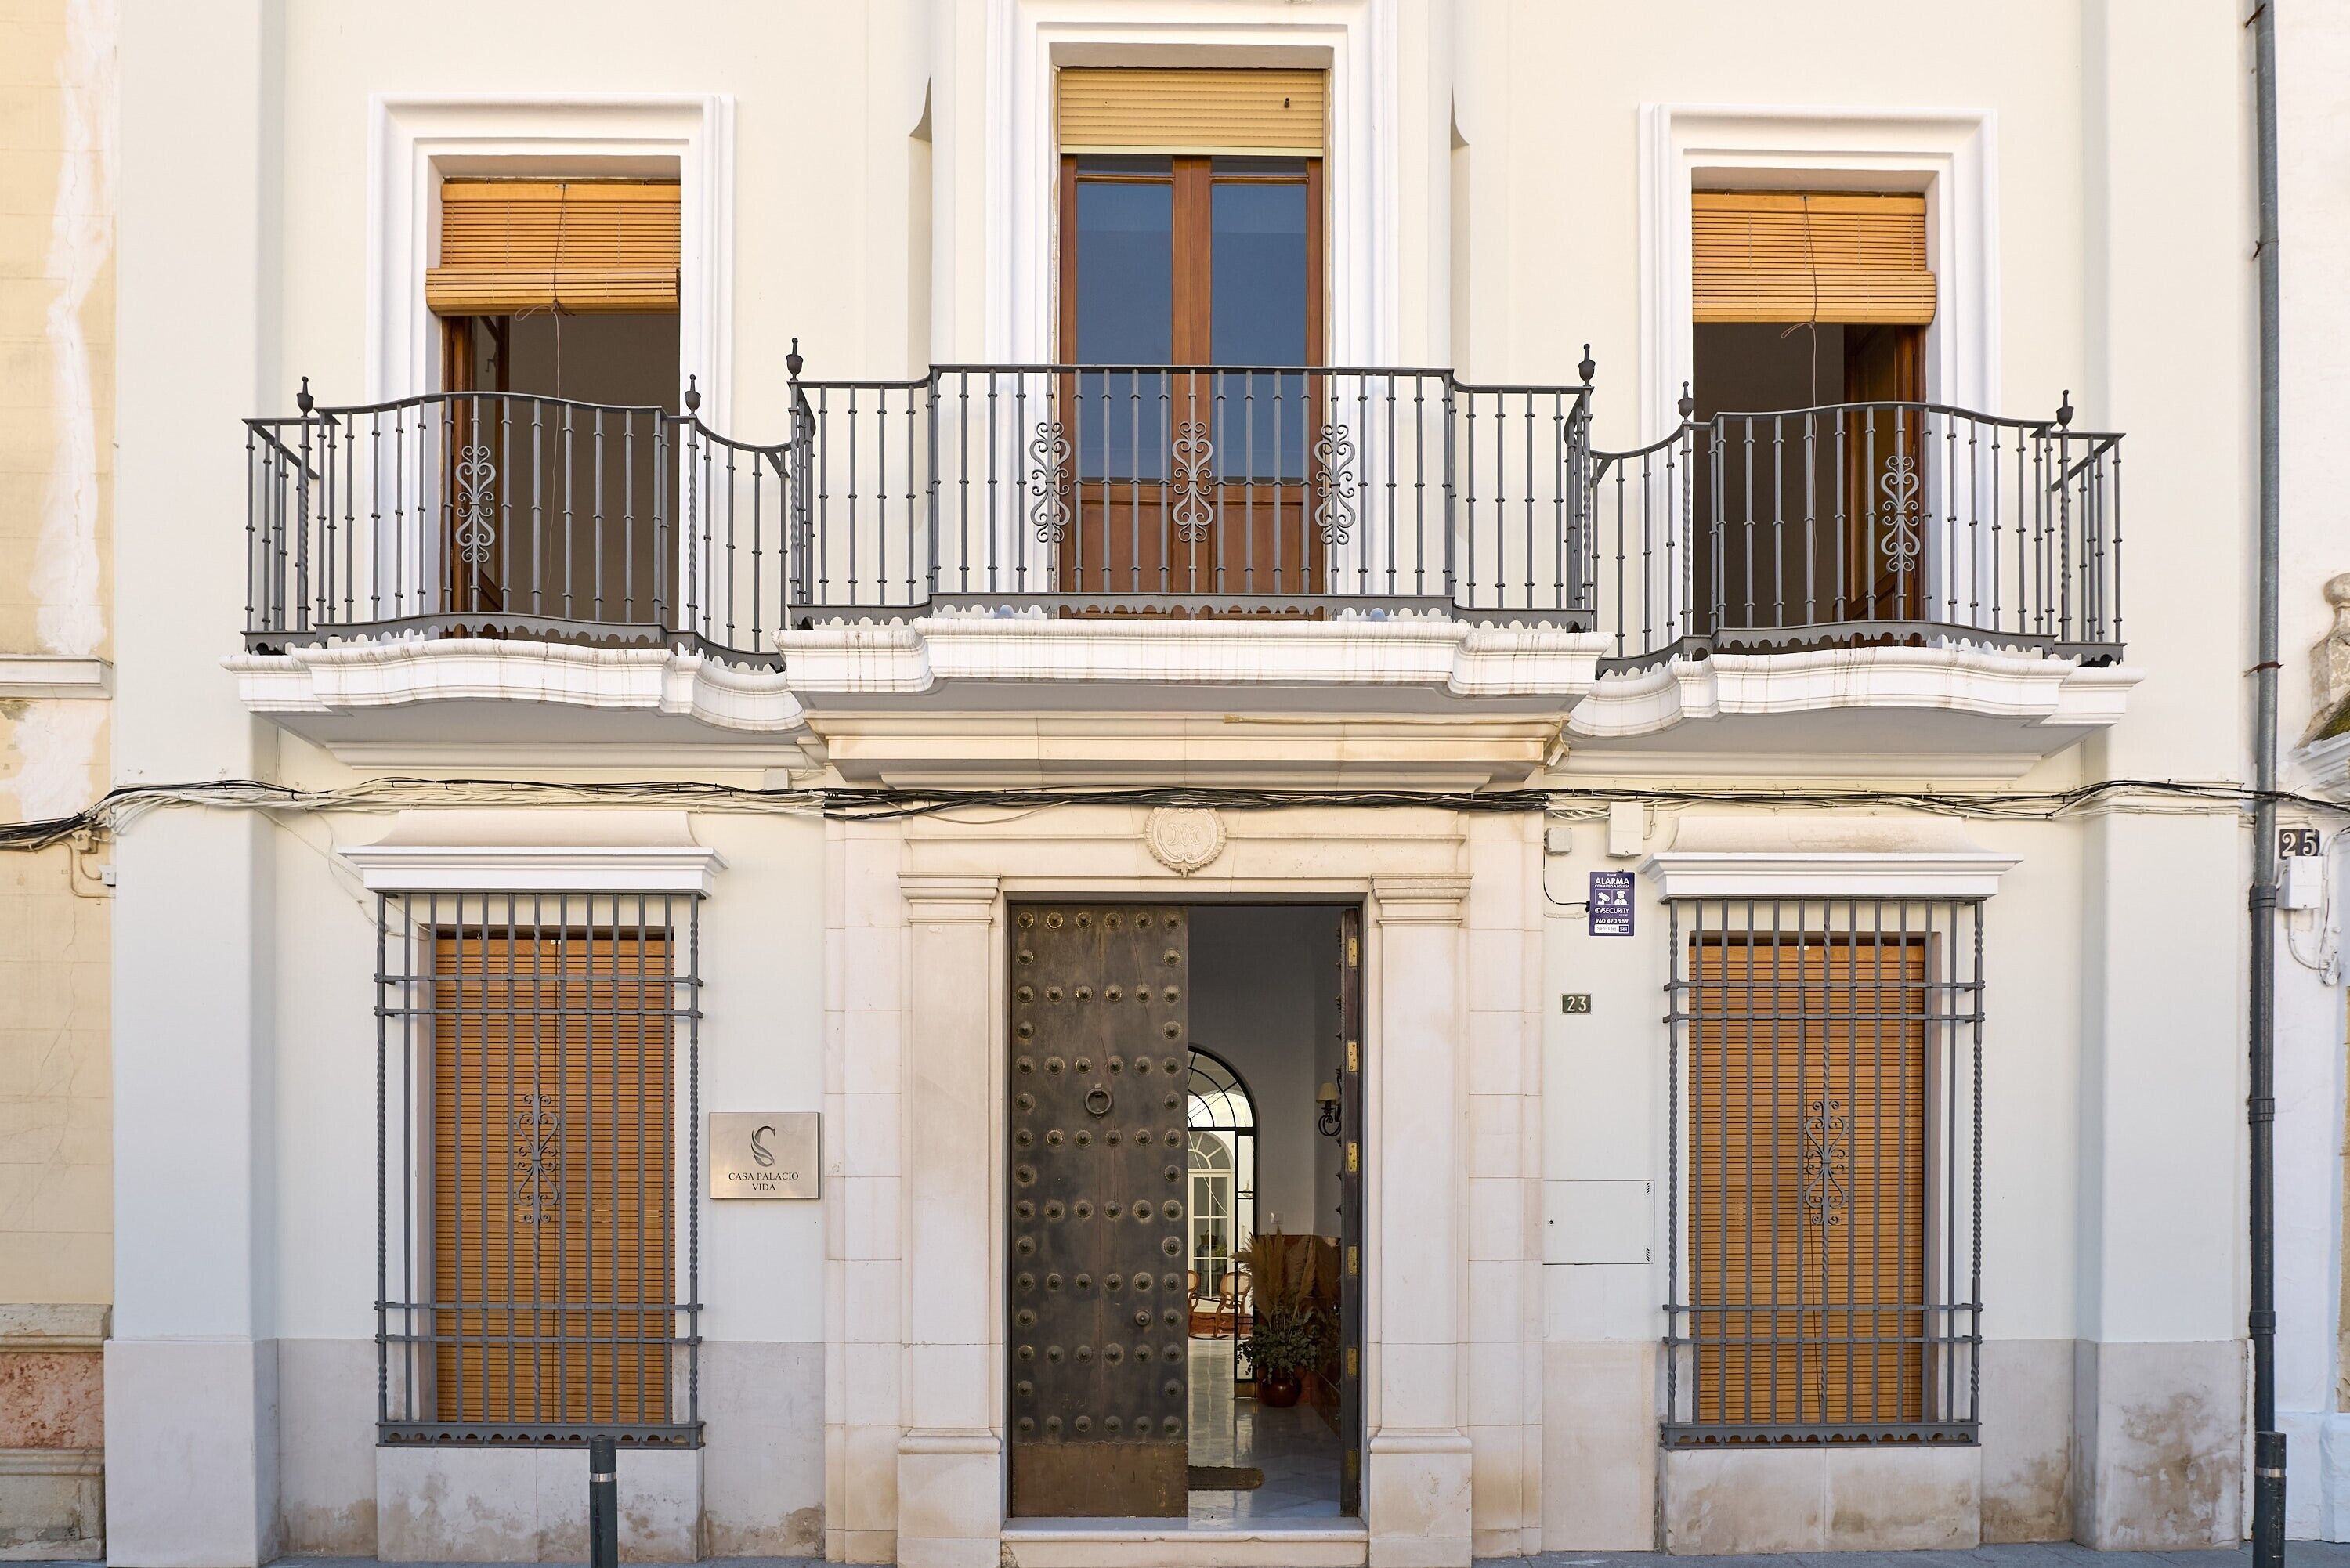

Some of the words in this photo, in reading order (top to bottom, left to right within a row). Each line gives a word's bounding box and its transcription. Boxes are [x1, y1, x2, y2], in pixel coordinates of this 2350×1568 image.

[2282, 831, 2317, 856] 25
[1567, 995, 1587, 1012] 23
[757, 1172, 799, 1180] PALACIO
